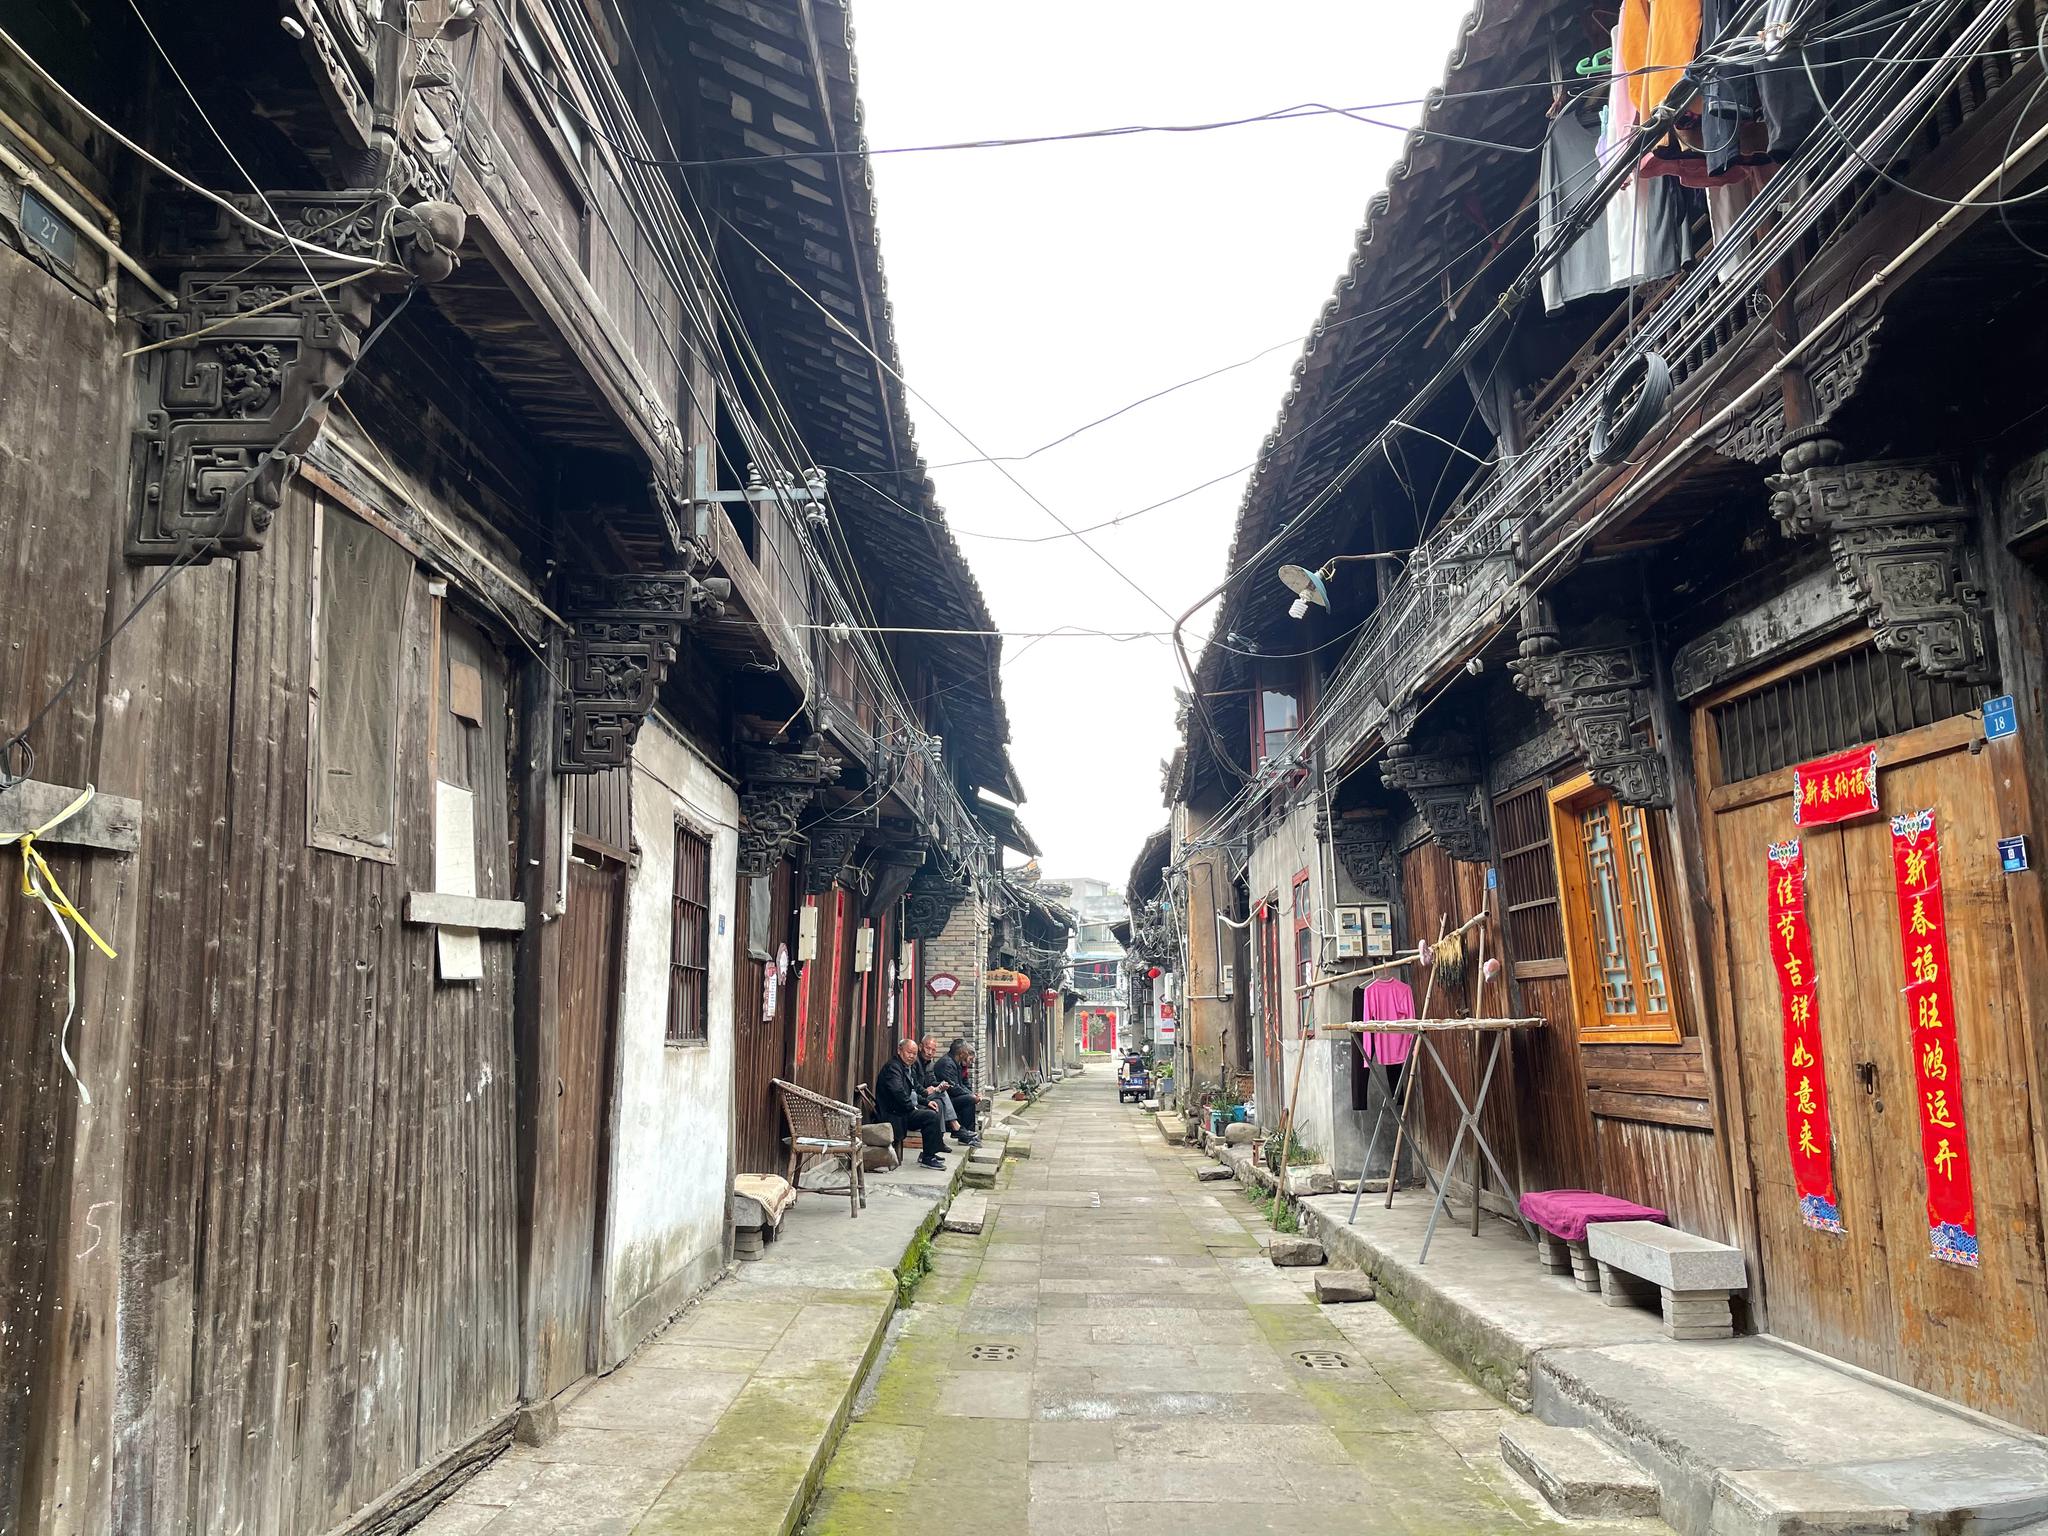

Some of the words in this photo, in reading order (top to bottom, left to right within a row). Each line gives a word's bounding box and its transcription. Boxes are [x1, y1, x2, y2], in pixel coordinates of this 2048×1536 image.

[40, 216, 59, 244] 27
[1994, 716, 2006, 732] 18
[1803, 767, 1865, 808] 新春纳福
[1776, 871, 1822, 1159] 佳节吉祥如意来
[1904, 849, 1959, 1182] 新春福旺鸿运开
